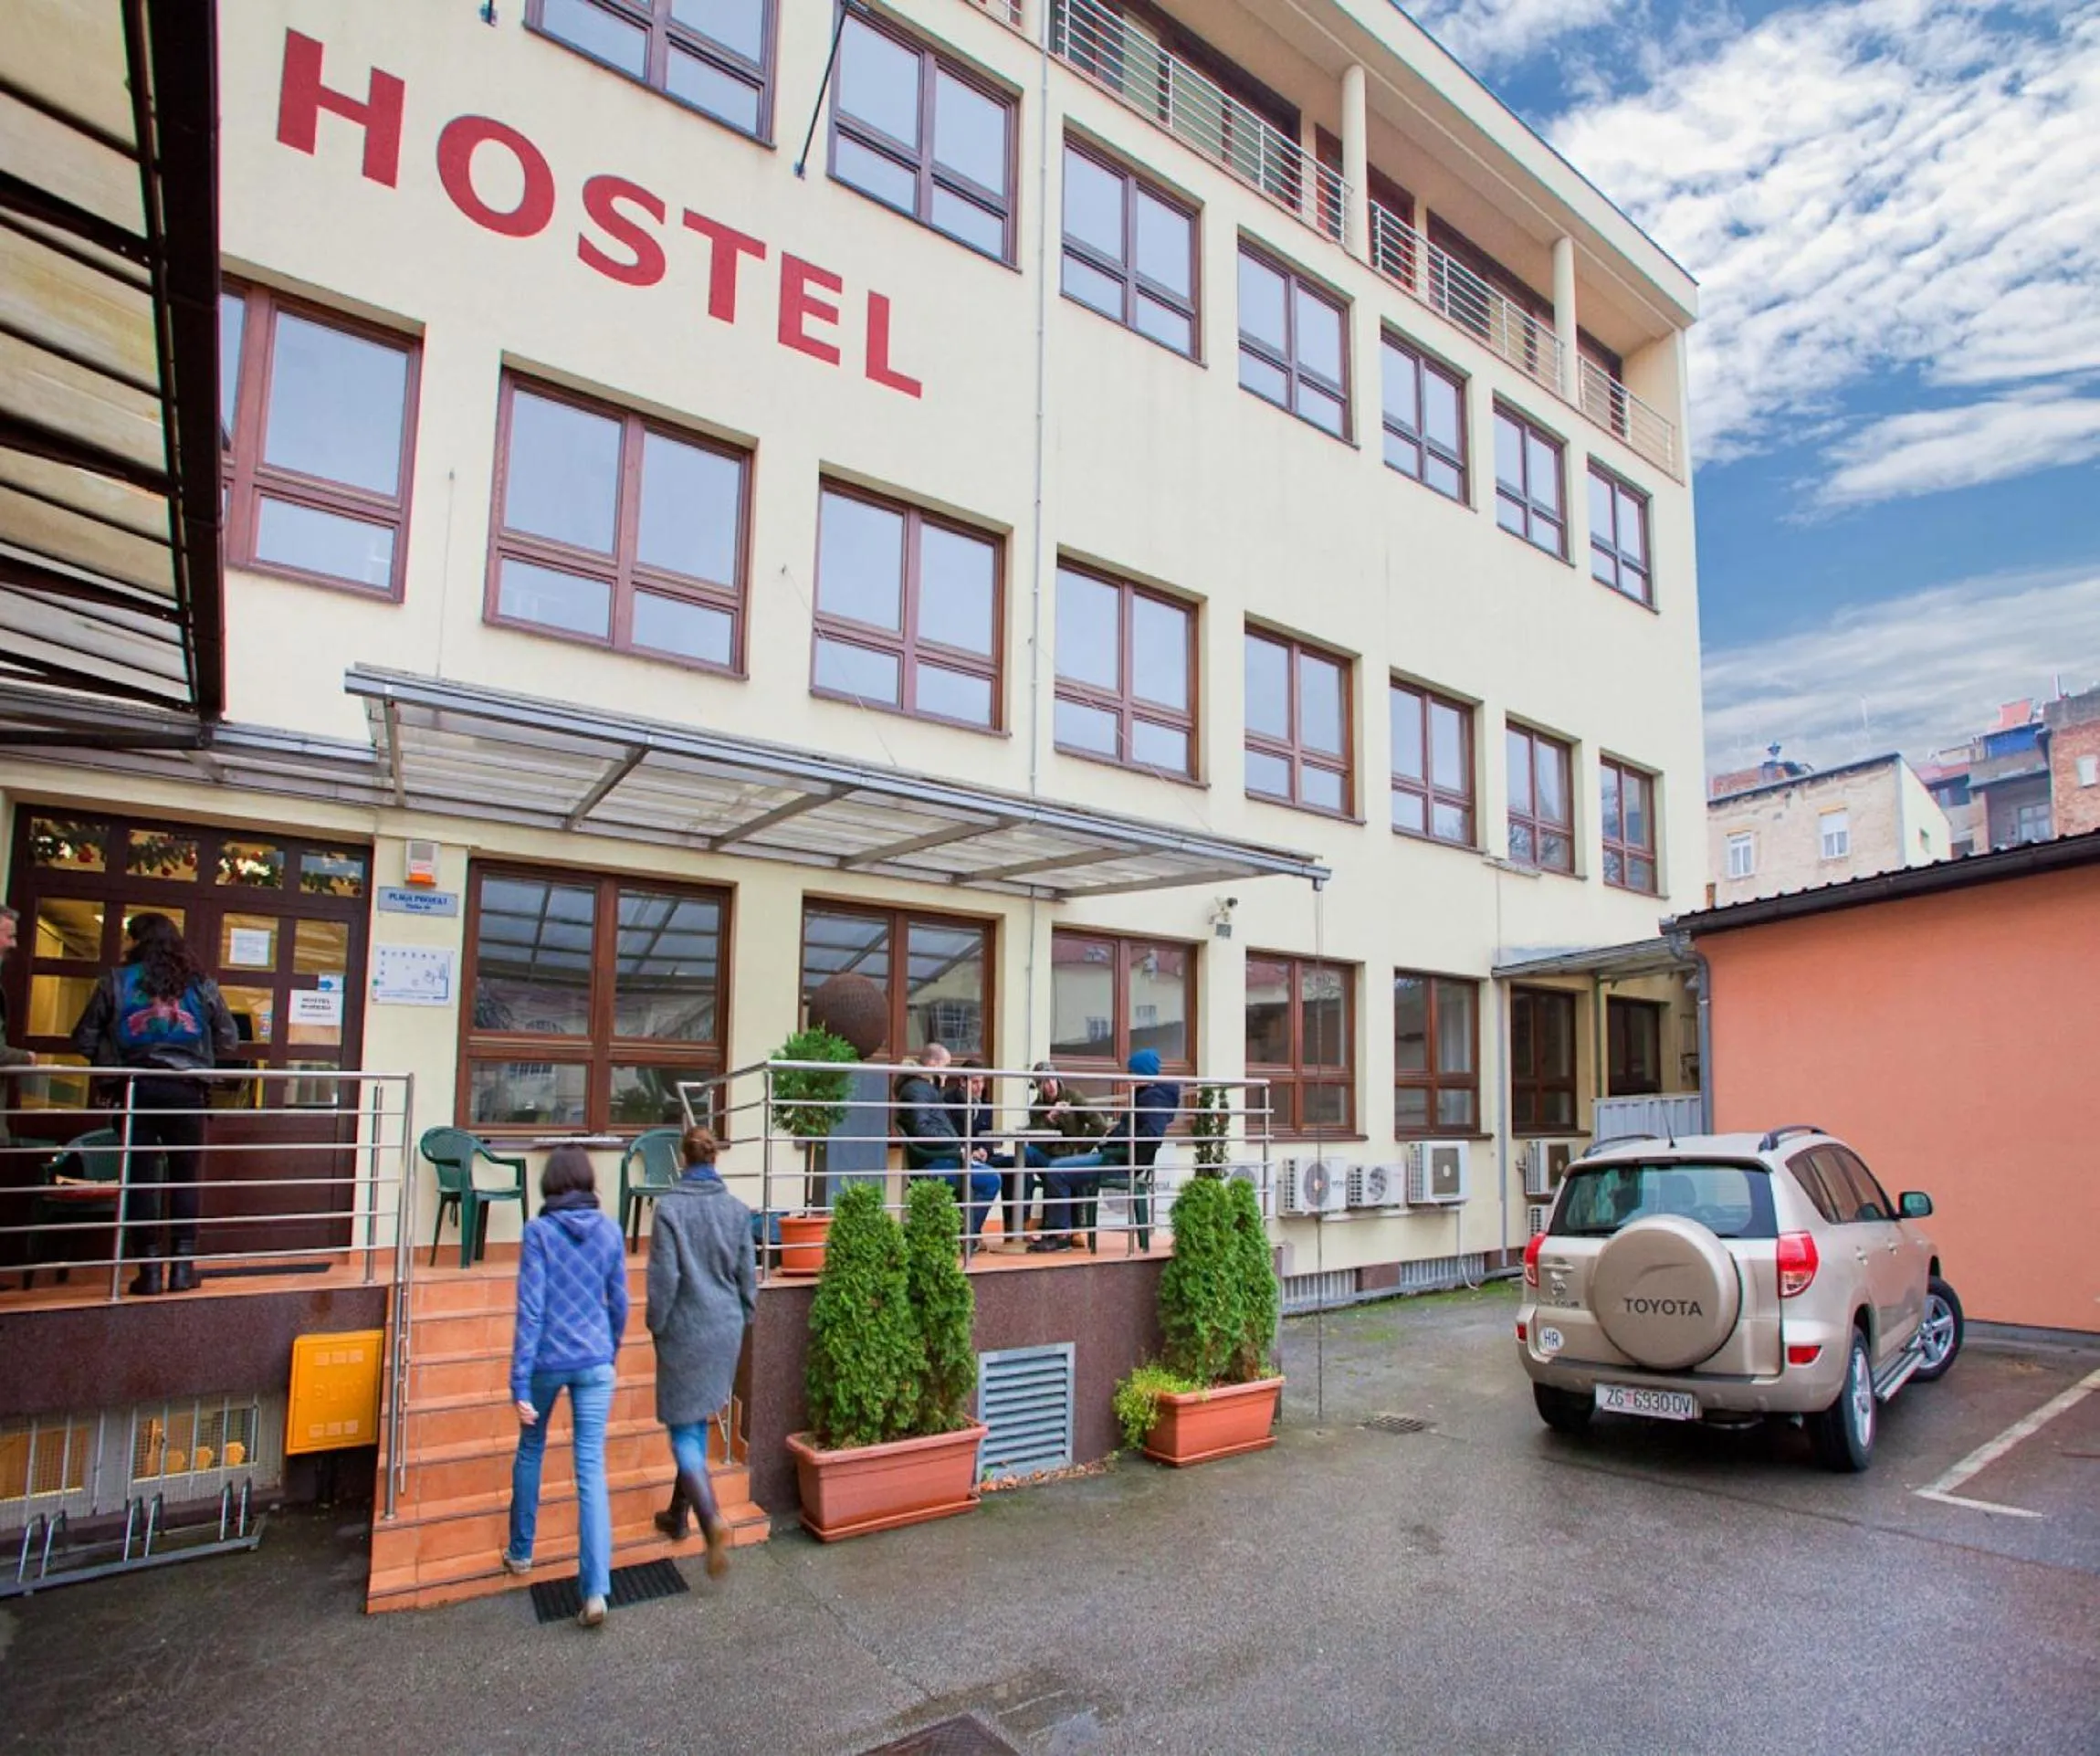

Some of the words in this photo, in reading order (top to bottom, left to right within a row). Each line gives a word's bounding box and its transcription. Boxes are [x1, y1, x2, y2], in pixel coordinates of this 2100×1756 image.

[277, 27, 922, 399] HOSTEL
[1623, 1298, 1703, 1316] TOYOTA
[1543, 1330, 1559, 1347] HR
[1607, 1388, 1624, 1407] ZG
